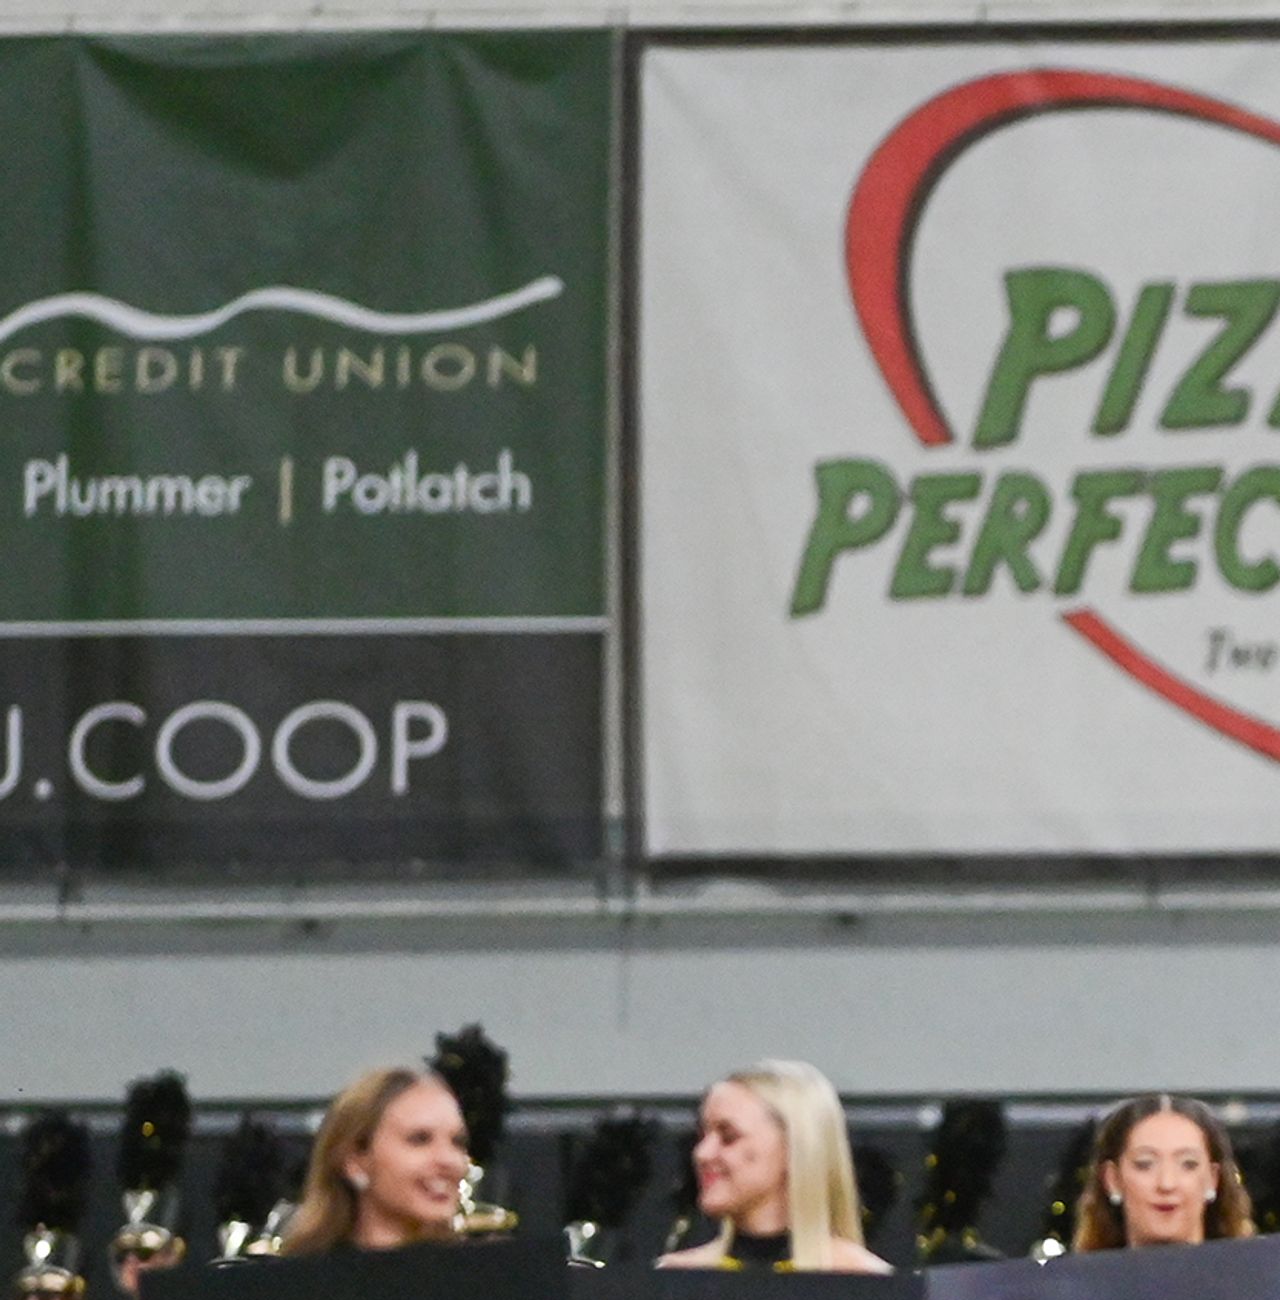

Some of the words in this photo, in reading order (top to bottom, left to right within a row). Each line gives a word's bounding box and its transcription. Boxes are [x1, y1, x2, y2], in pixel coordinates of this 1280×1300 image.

[0, 345, 244, 394] CREDIT
[283, 343, 538, 393] UNION
[23, 453, 253, 518] Plummer
[322, 446, 534, 515] Potlatch
[1205, 624, 1278, 675] Two
